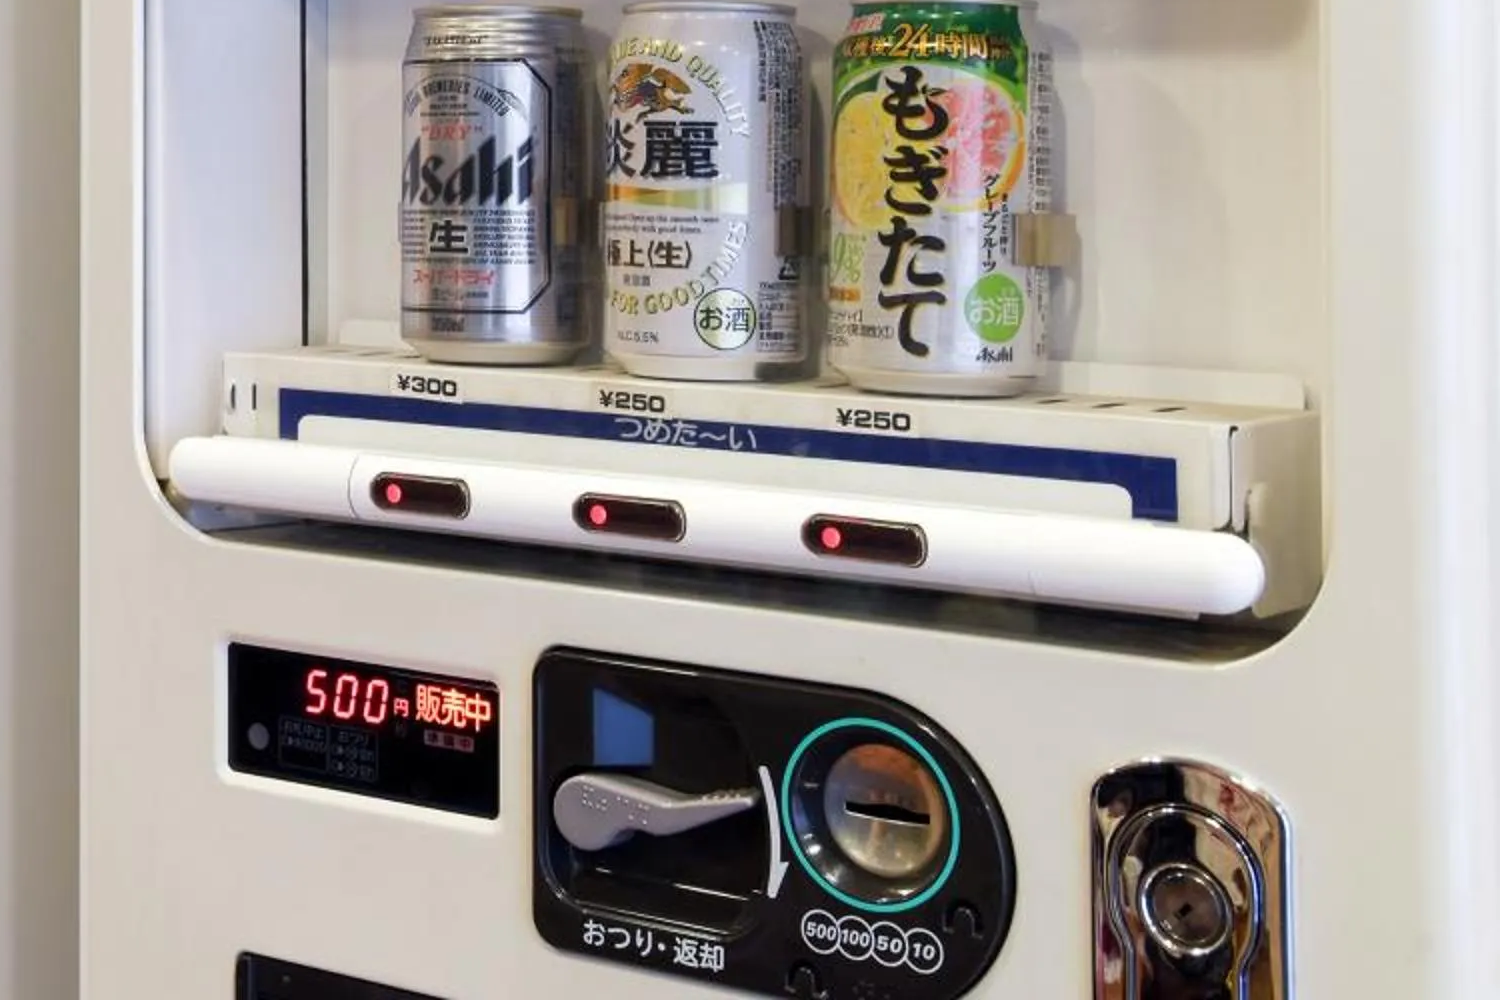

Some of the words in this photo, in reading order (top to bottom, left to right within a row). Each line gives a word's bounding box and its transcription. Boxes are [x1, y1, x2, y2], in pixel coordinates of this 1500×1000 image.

[402, 135, 534, 206] Asahi
[877, 65, 949, 358] もぎたて
[982, 173, 1001, 273] グレープフルーツ
[429, 219, 470, 254] 生
[643, 278, 706, 315] GOOD
[969, 297, 1020, 326] お酒
[699, 306, 751, 333] お酒
[397, 374, 458, 398] ¥300
[599, 389, 666, 412] ¥250
[613, 415, 758, 451] つめた〜い
[836, 408, 911, 431] ¥250
[305, 669, 389, 725] 500
[393, 697, 410, 718] 円
[415, 683, 493, 733] 販売中
[582, 917, 725, 973] おつり・返却
[805, 922, 838, 942] 500
[841, 929, 870, 949] 100
[876, 935, 903, 954] 50
[913, 943, 936, 961] 10
